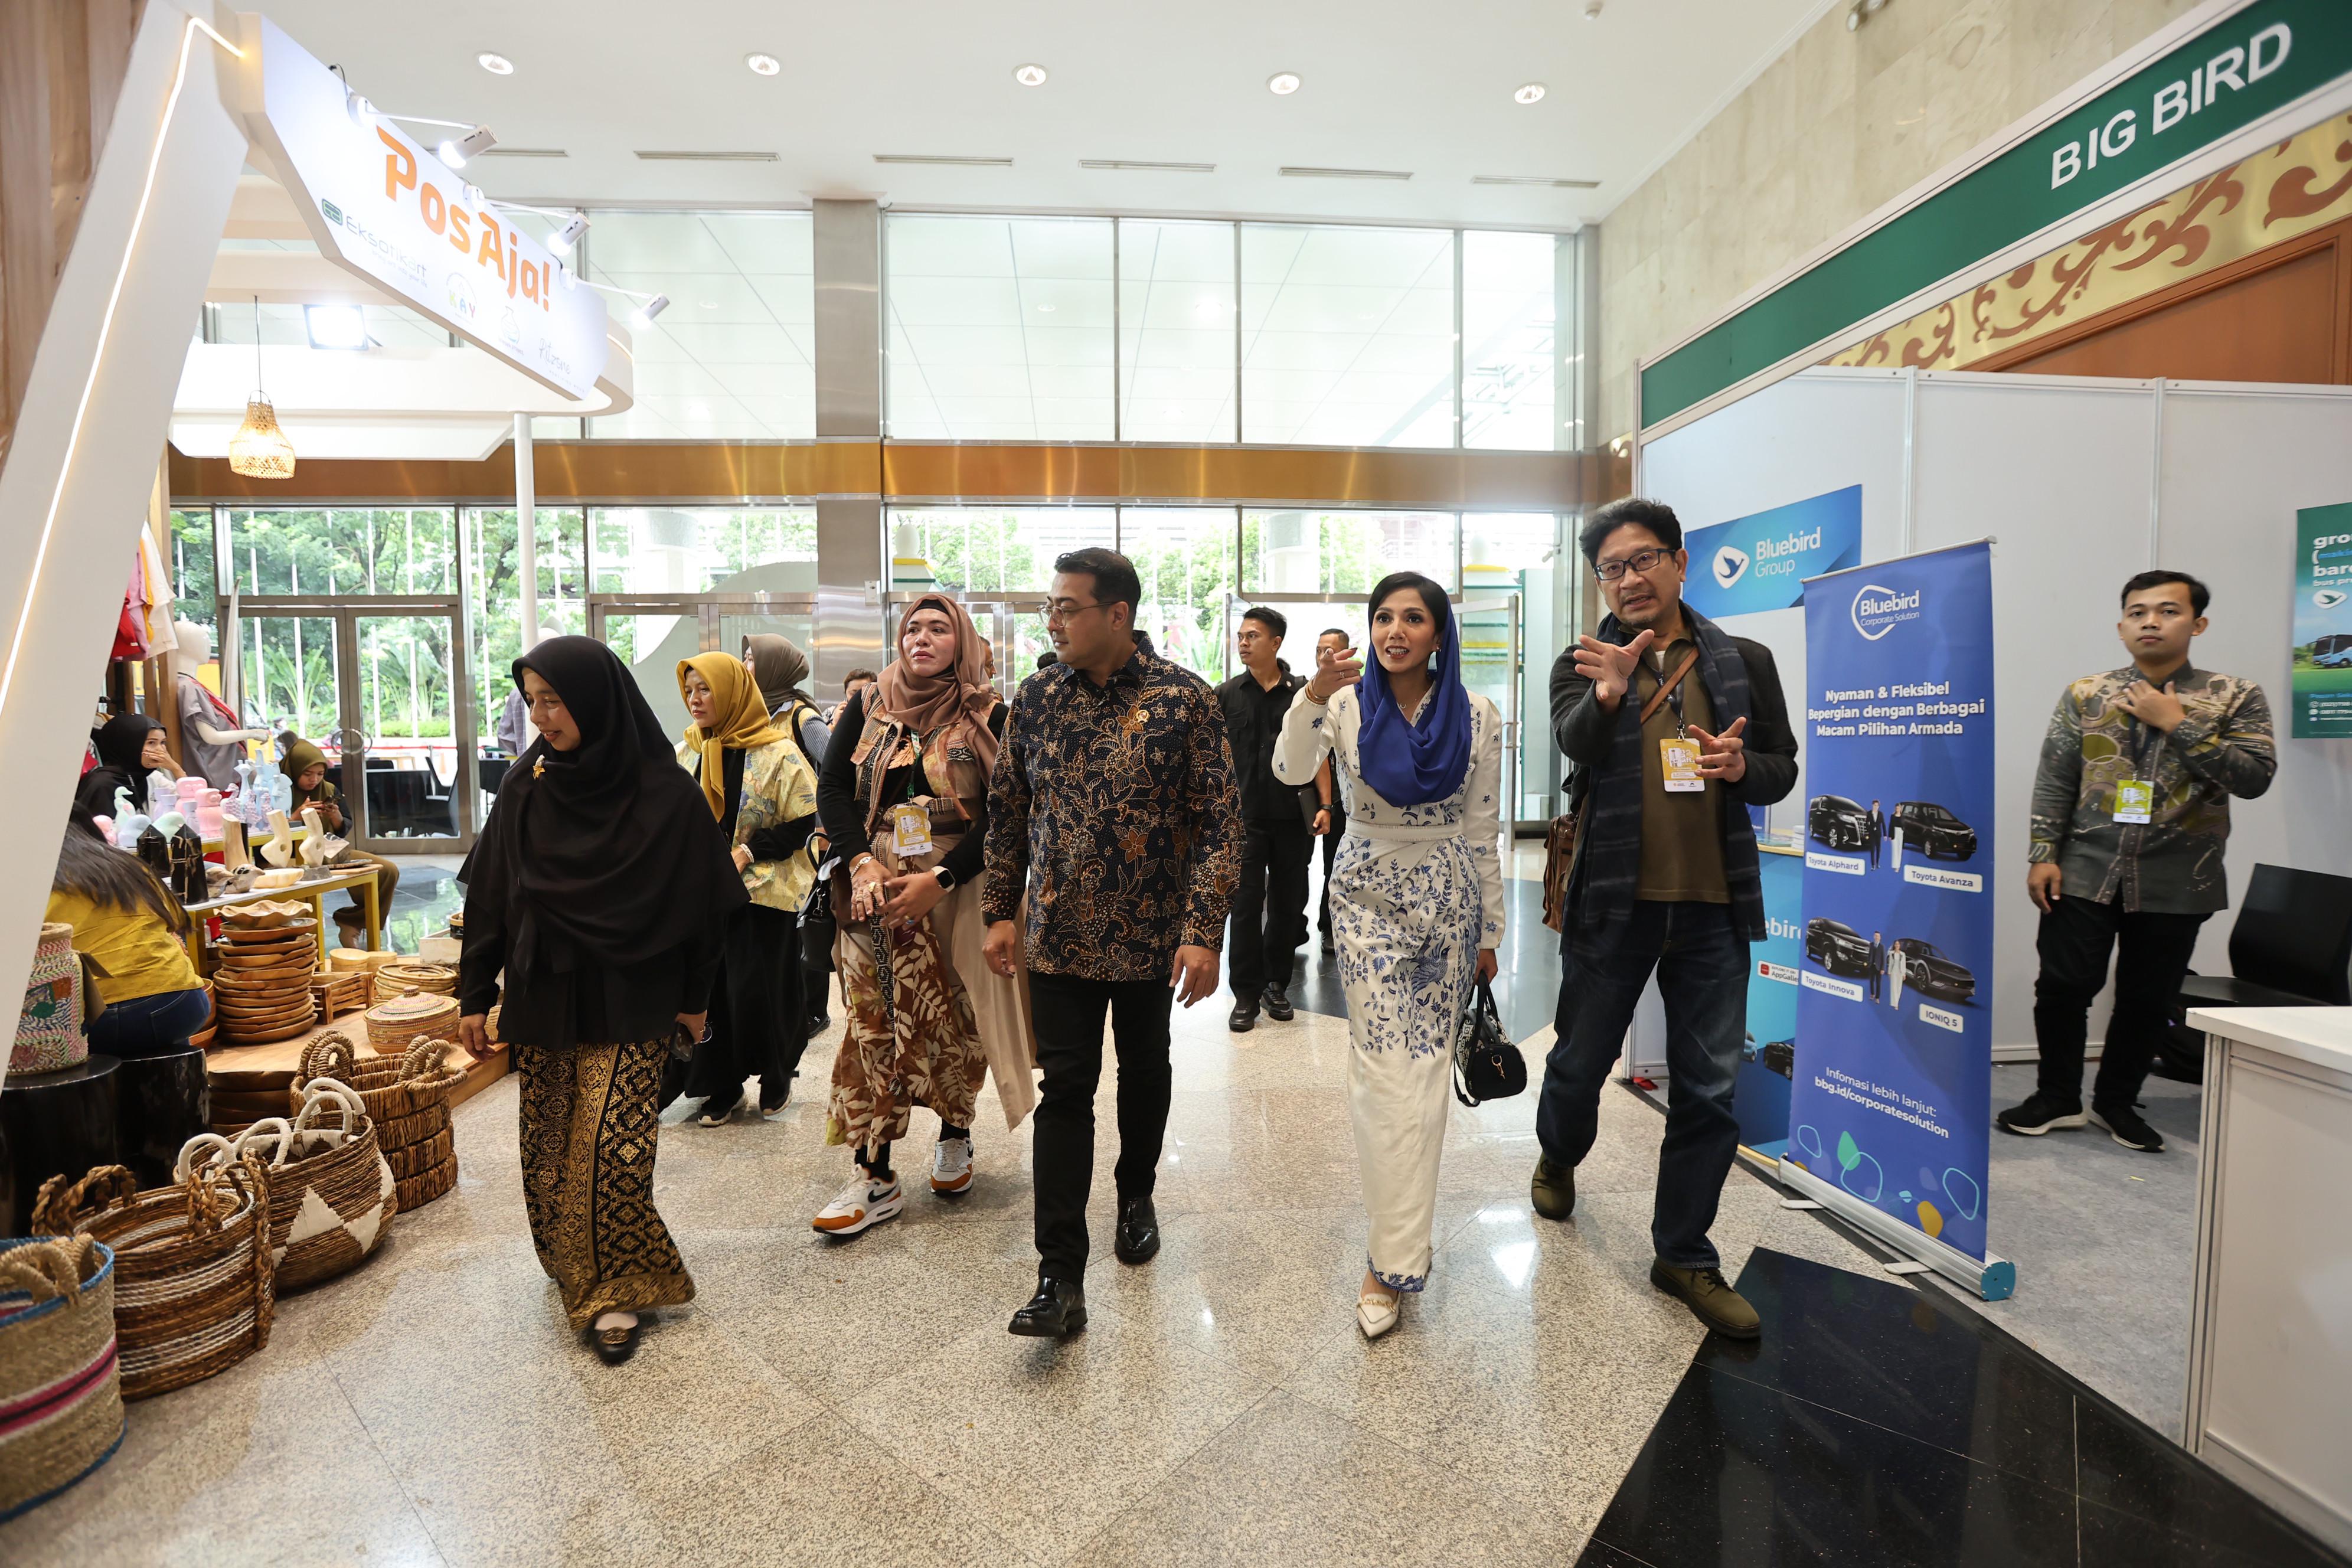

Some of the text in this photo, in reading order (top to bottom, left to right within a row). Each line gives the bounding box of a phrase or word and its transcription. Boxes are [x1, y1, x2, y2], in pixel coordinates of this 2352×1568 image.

[2050, 22, 2292, 190] BIG BIRD
[376, 125, 550, 312] PosAja!
[449, 289, 476, 318] KAY
[1756, 526, 1821, 560] Bluebird
[2313, 534, 2352, 549] gro
[1755, 559, 1795, 577] Group
[1860, 590, 1920, 616] Bluebird
[1860, 611, 1920, 626] Corporate Solution
[1825, 681, 1949, 704] Nyaman & Fleksibel
[1808, 698, 1985, 721] Bepergian dengan Berbagai
[1817, 720, 1963, 736] Macam Pilihan Armada
[1808, 857, 1859, 871] Toyota Alphard
[1912, 871, 1974, 887] Toyota Avanza
[1765, 917, 1801, 939] bir
[1805, 975, 1856, 997] Toyota Innova
[1926, 1010, 1958, 1027] IONIQ 5
[1825, 1066, 1937, 1117] Infomasi lebih lanjut:
[1814, 1076, 1949, 1139] bbg.id/corporatesolution
